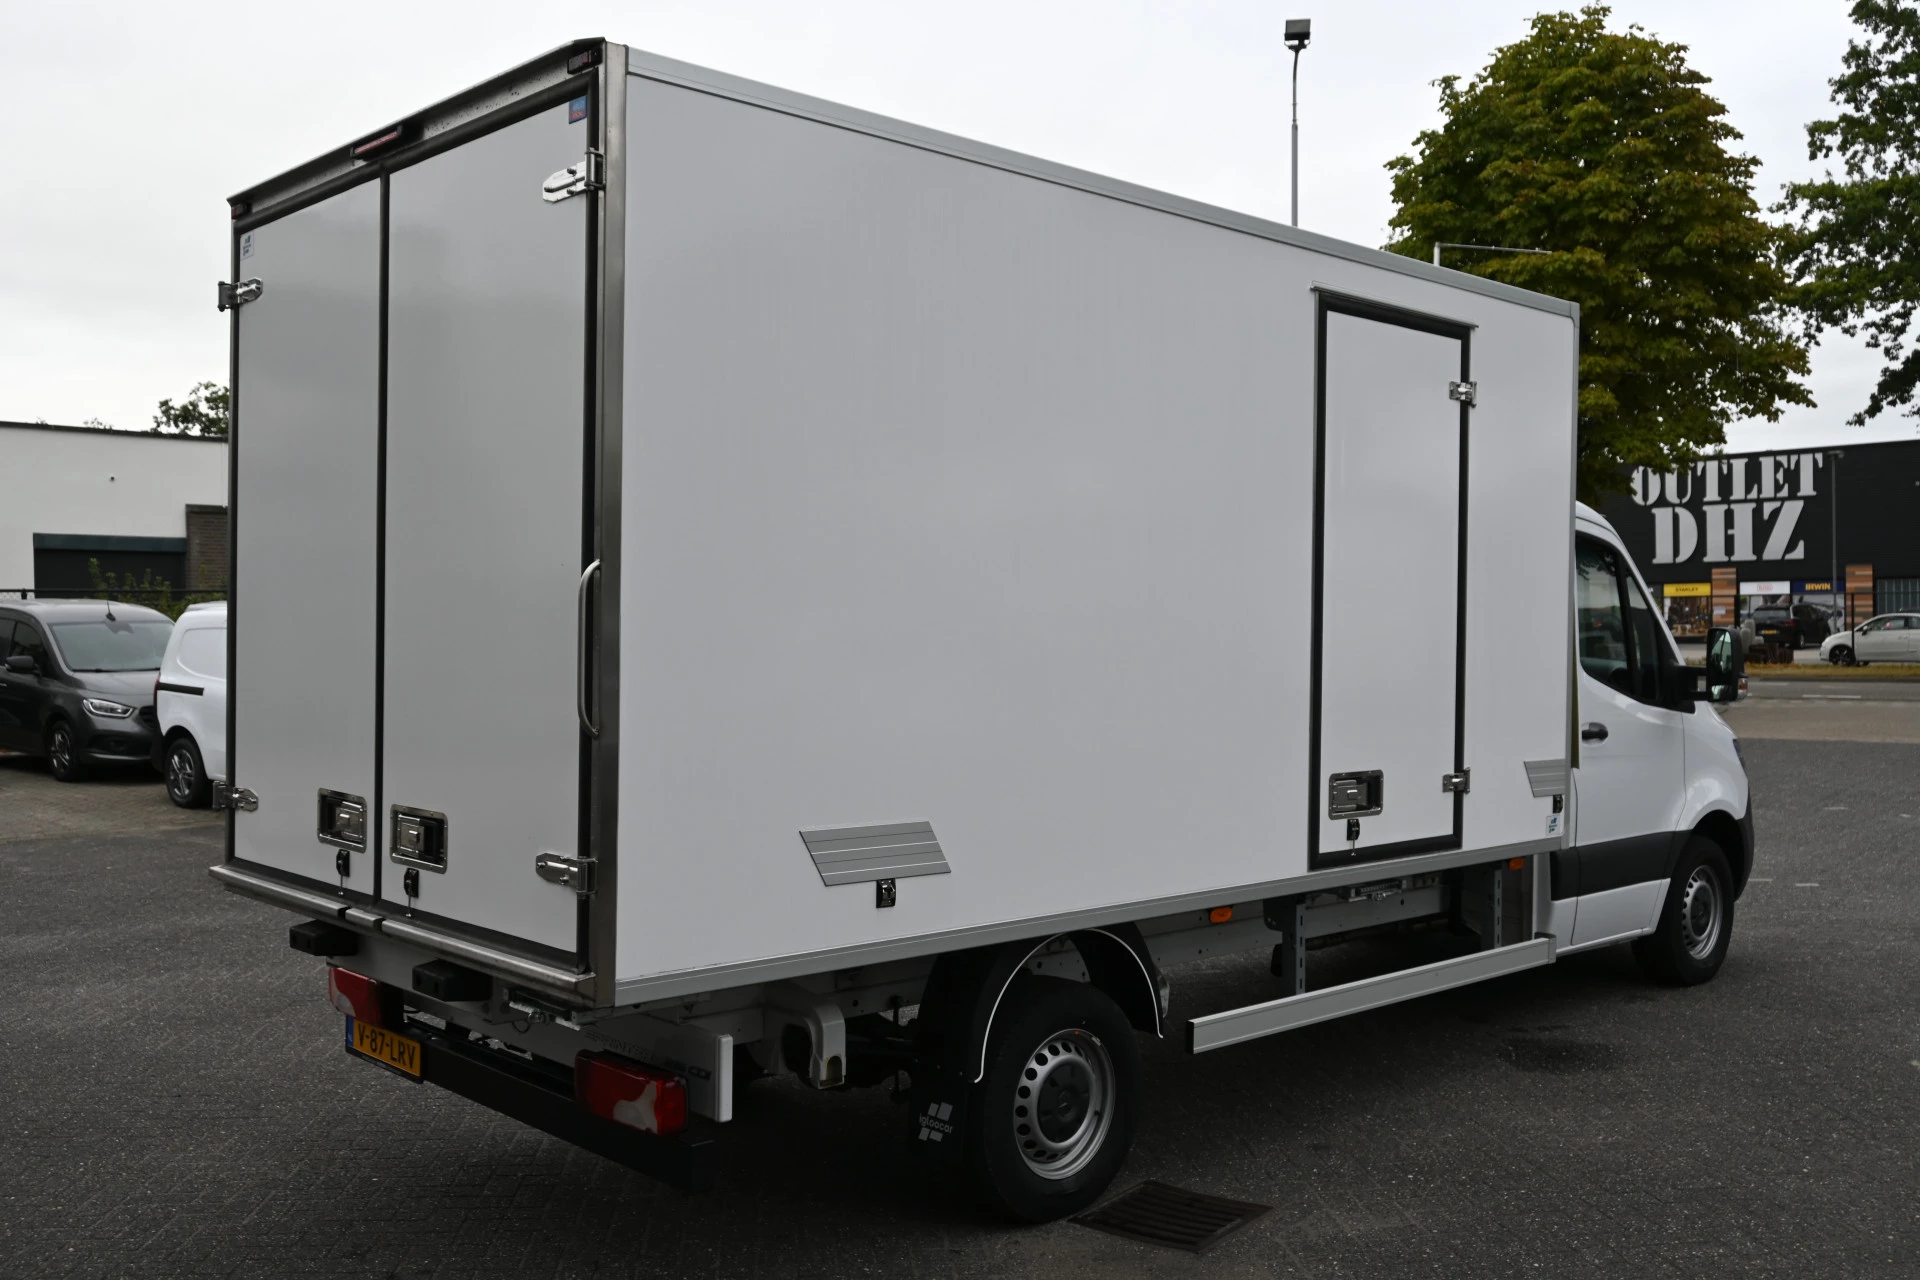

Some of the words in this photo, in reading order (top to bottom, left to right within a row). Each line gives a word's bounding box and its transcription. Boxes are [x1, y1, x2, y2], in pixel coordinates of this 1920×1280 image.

[1630, 452, 1824, 506] OUTLET
[1651, 500, 1805, 565] DHZ
[1805, 582, 1831, 591] IRWIN
[358, 1023, 416, 1069] V-87-LRV
[919, 1112, 953, 1134] igloocar
